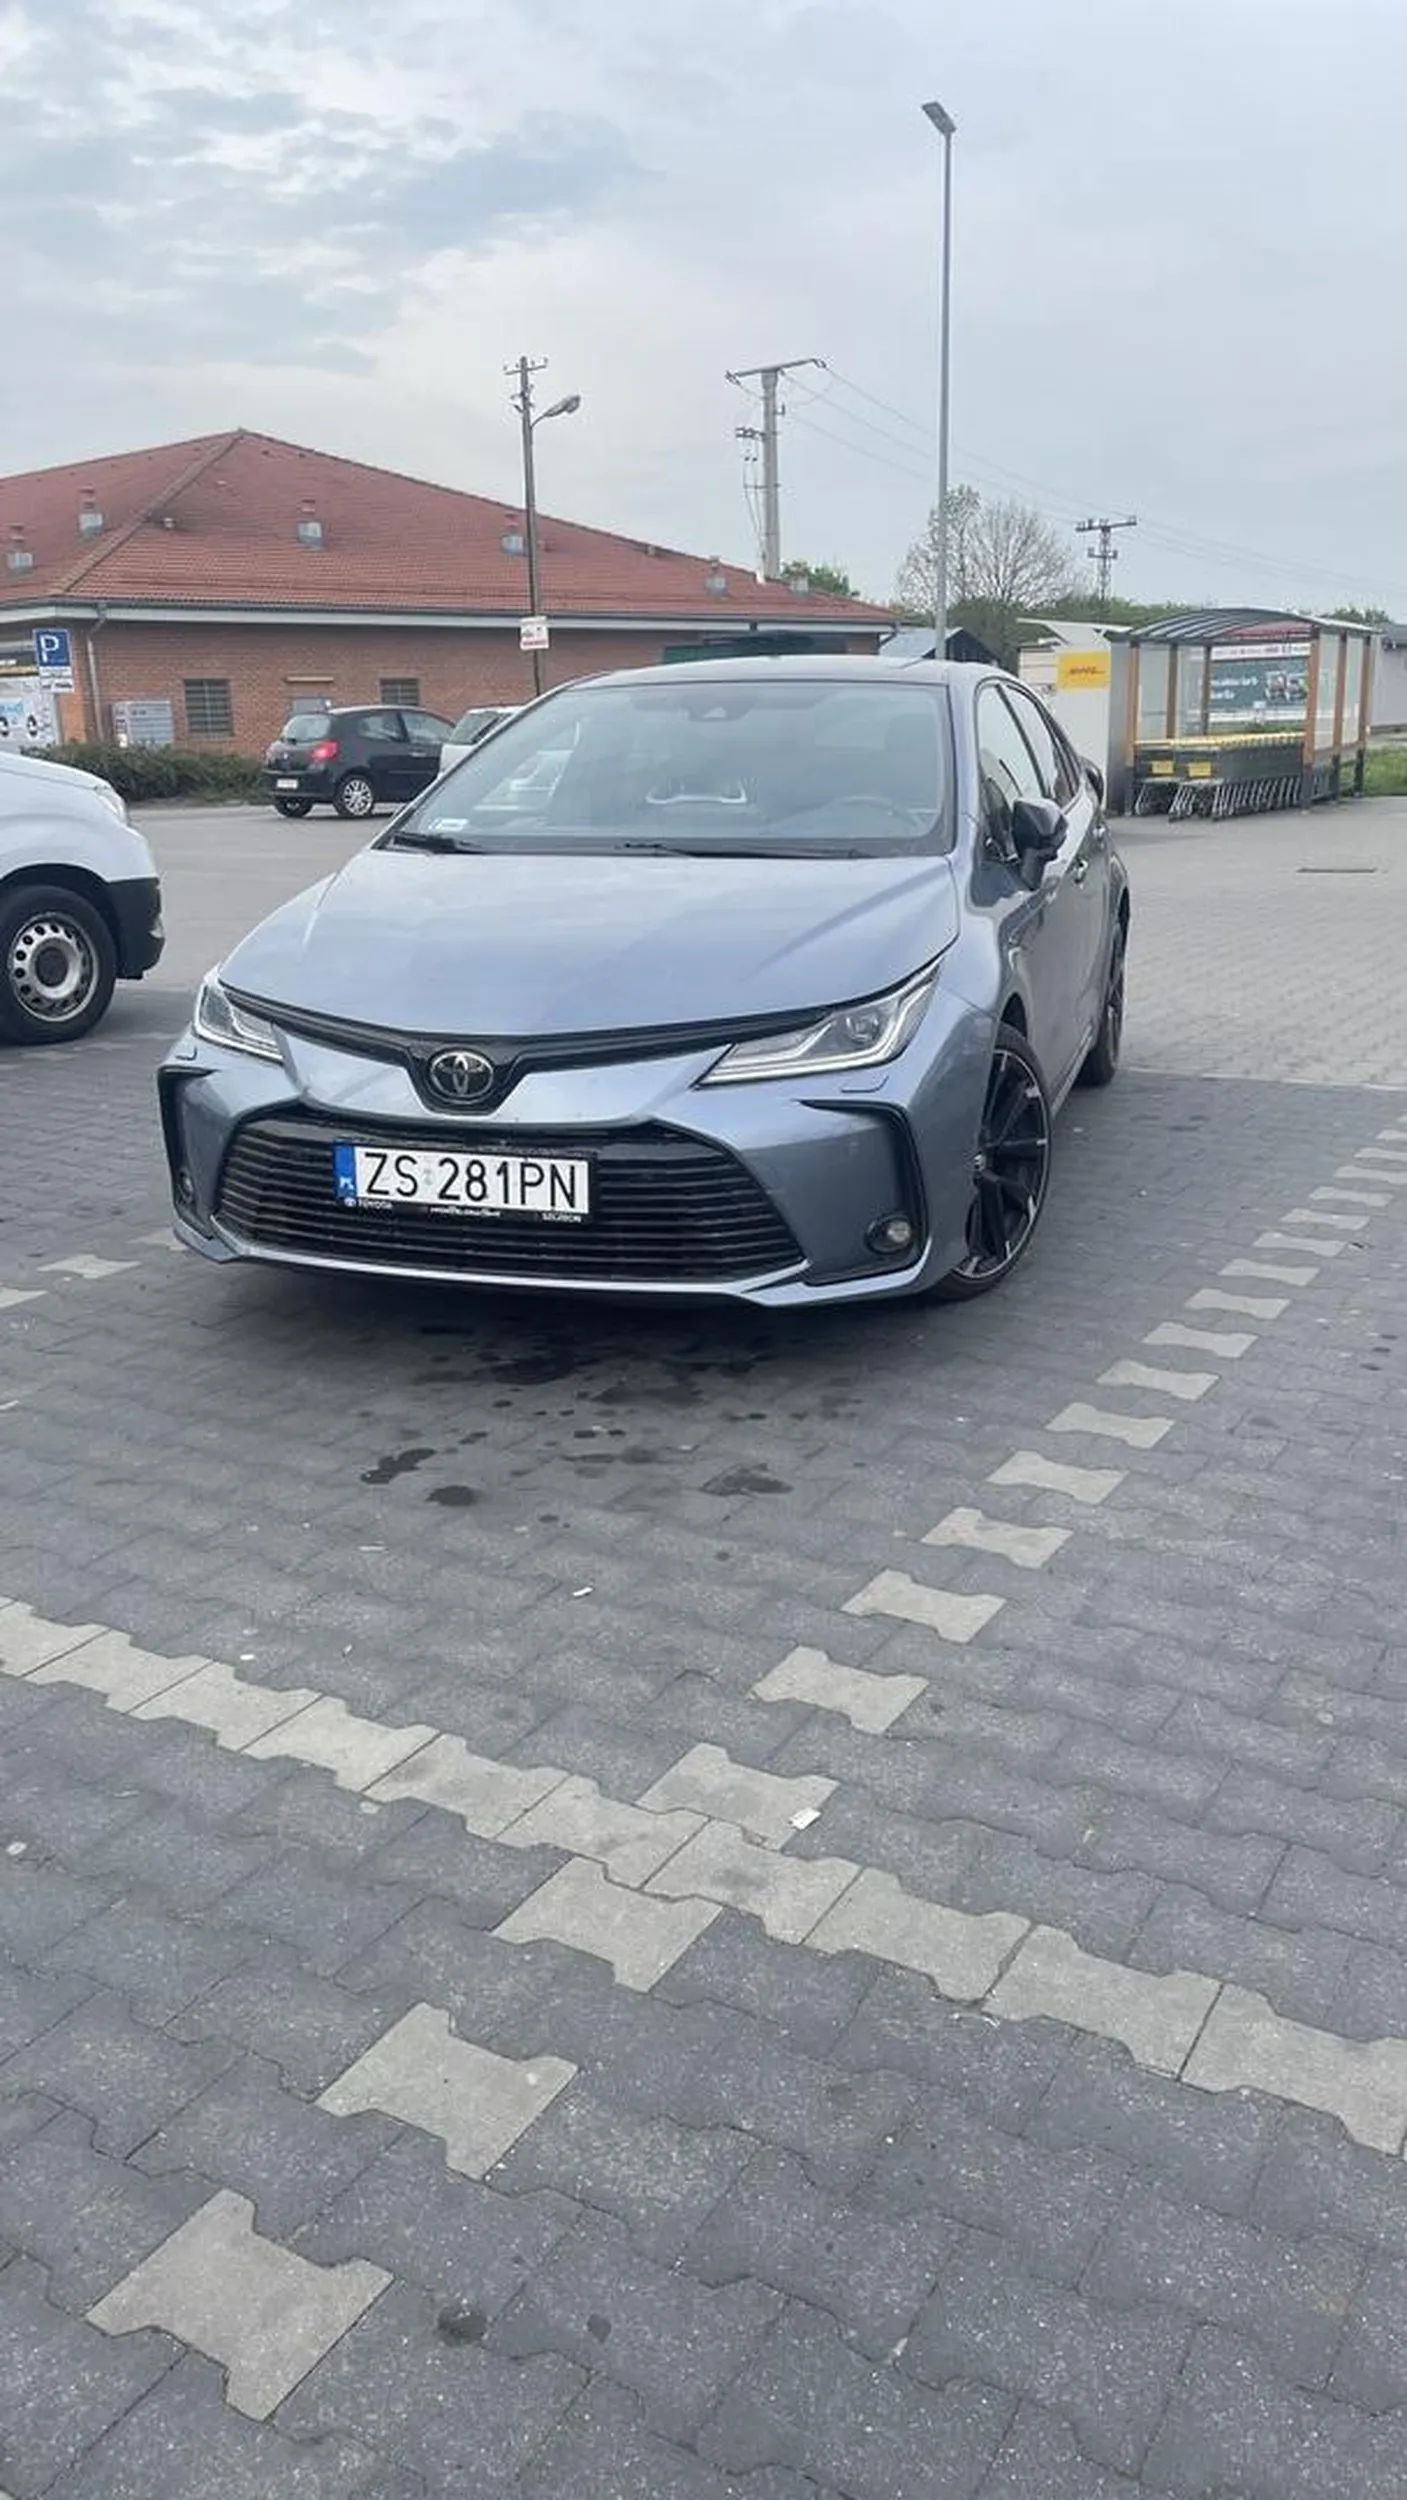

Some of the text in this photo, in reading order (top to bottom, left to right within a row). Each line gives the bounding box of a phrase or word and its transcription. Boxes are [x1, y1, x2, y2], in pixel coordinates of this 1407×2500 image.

[40, 634, 59, 663] P
[364, 1152, 576, 1208] ZS 281PN
